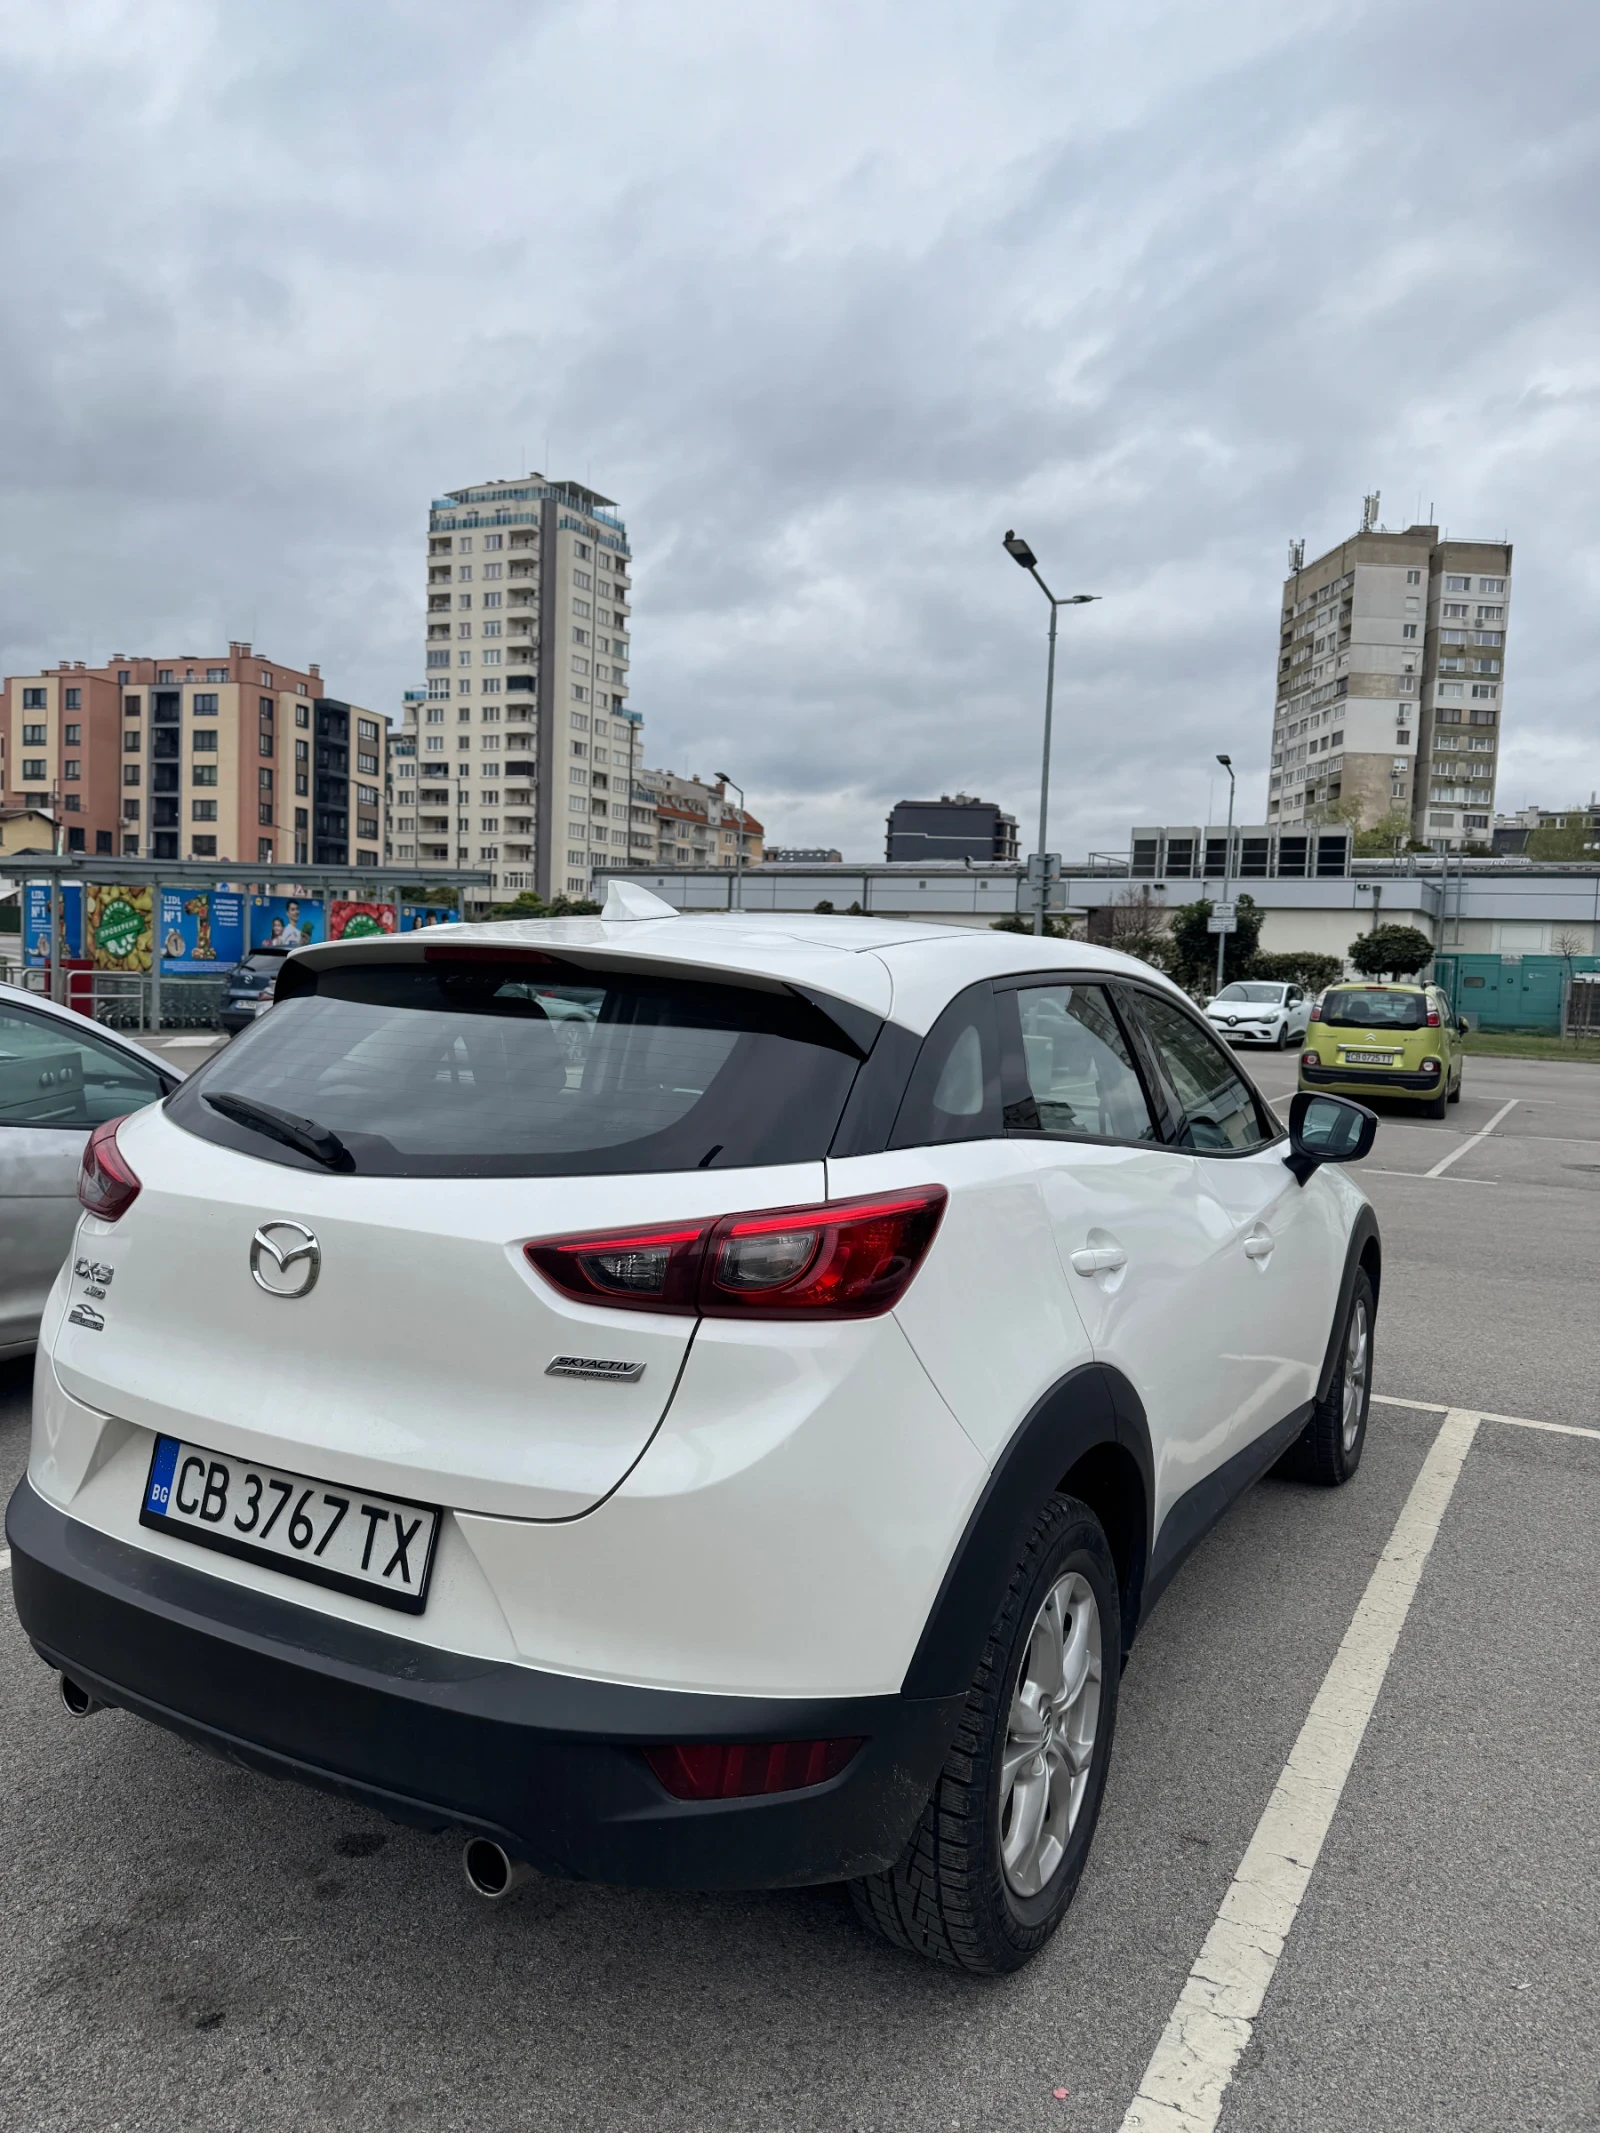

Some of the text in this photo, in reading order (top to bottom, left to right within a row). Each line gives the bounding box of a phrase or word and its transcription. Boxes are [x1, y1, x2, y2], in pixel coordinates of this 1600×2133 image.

[164, 895, 182, 905] LIDL
[176, 911, 182, 924] 1
[557, 1357, 635, 1371] SKYACTIV
[562, 1369, 623, 1378] TECHNOLOGY
[152, 1483, 168, 1504] BG
[175, 1456, 423, 1583] CB 3767 TX
